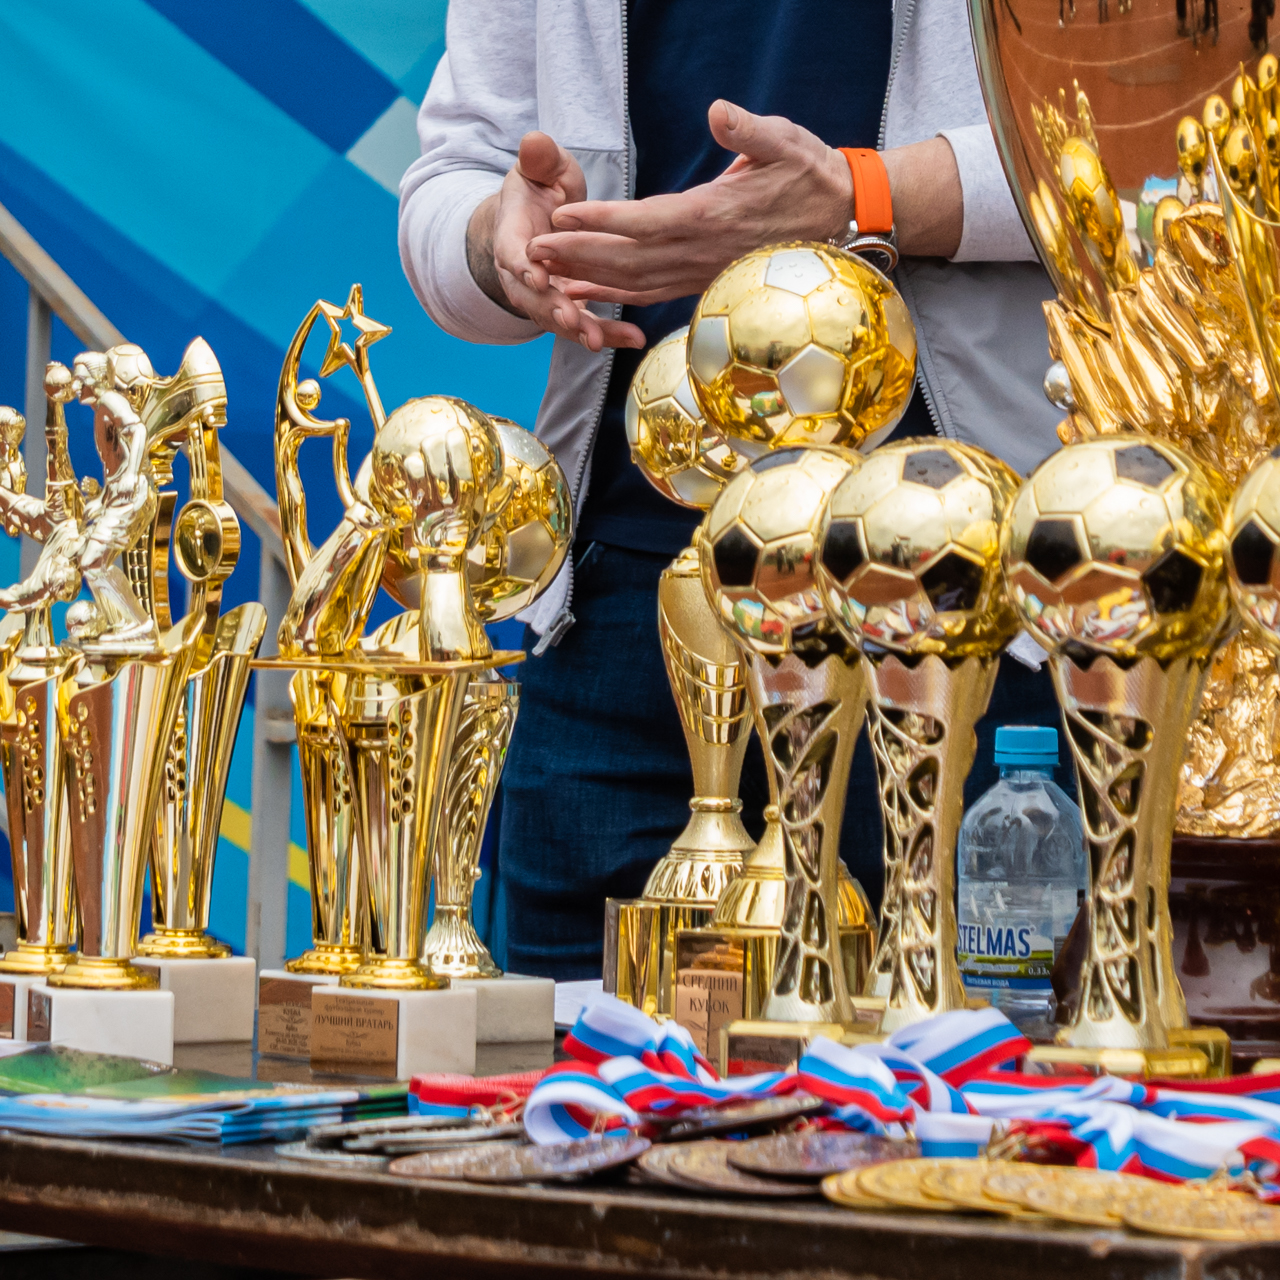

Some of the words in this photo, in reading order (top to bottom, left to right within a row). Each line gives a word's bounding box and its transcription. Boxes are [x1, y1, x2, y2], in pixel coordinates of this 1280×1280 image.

[682, 973, 738, 992] СРЕДНИЙ
[689, 996, 730, 1015] КУБОК
[314, 1014, 354, 1028] ЛУЧШИЙ
[355, 1017, 394, 1031] ВРАТАРЬ
